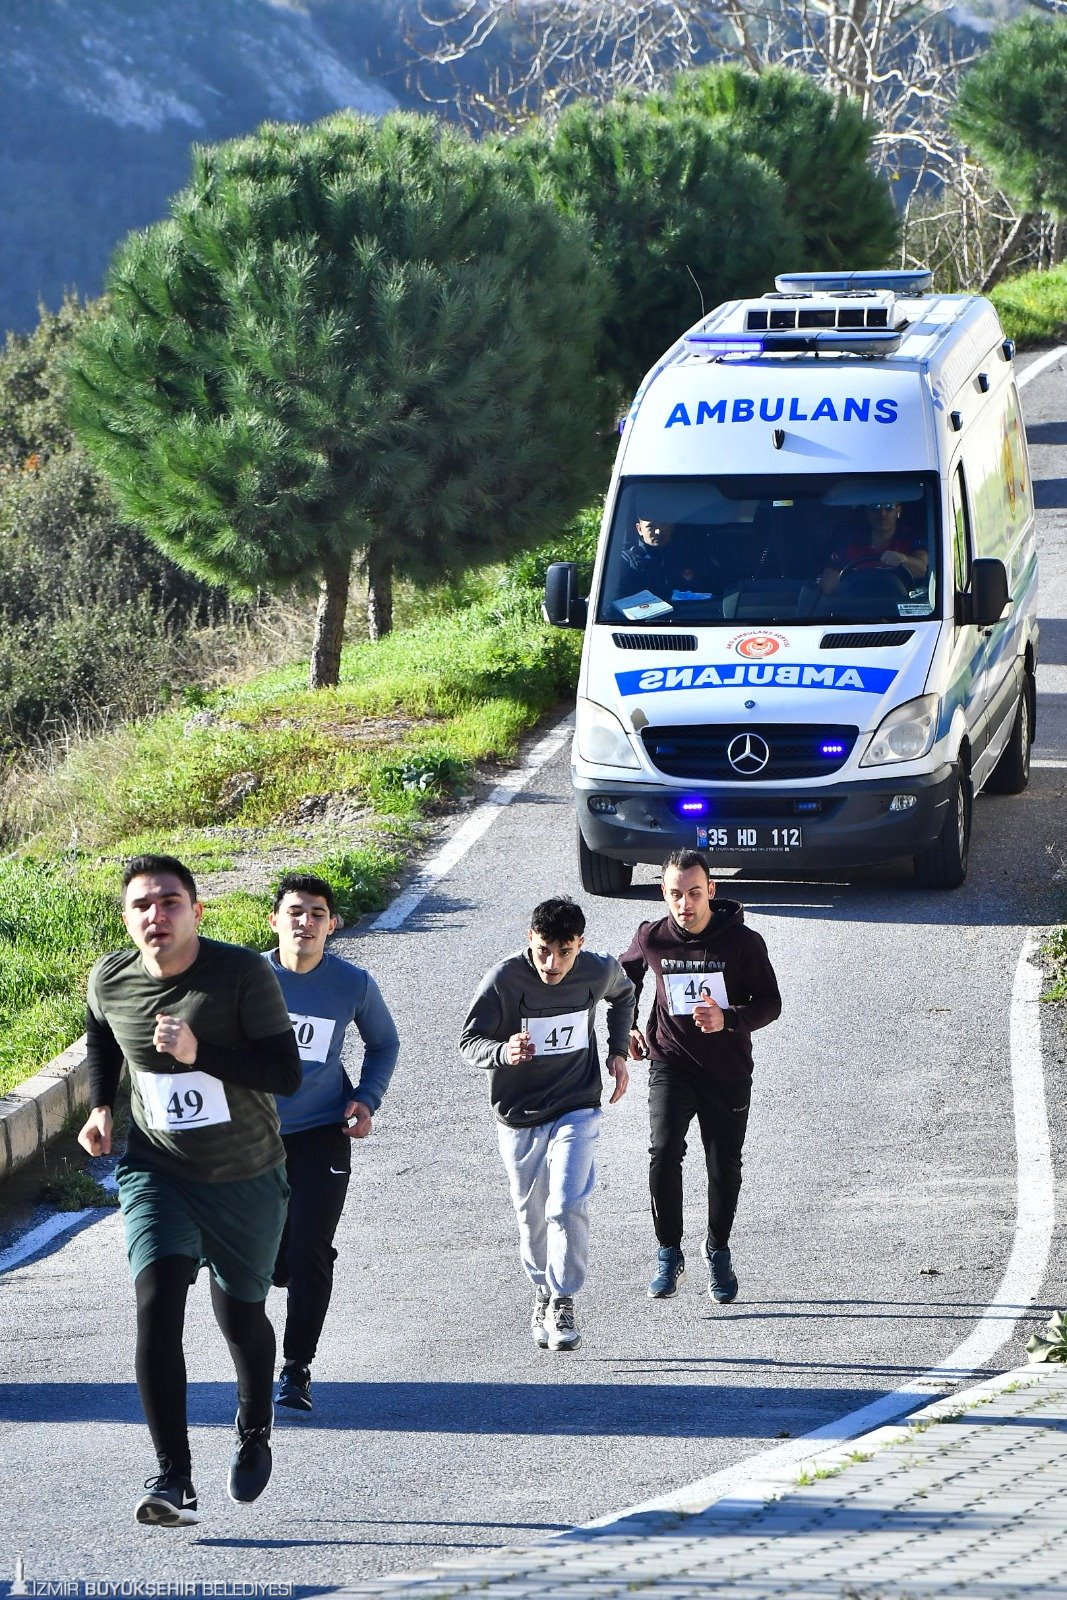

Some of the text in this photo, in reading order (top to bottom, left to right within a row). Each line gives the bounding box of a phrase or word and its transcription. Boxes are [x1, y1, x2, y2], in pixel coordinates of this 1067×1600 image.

[664, 397, 898, 428] AMBULANS
[708, 828, 800, 846] 35 HD 112
[684, 979, 711, 1000] 46
[544, 1026, 574, 1047] 47
[166, 1089, 204, 1119] 49
